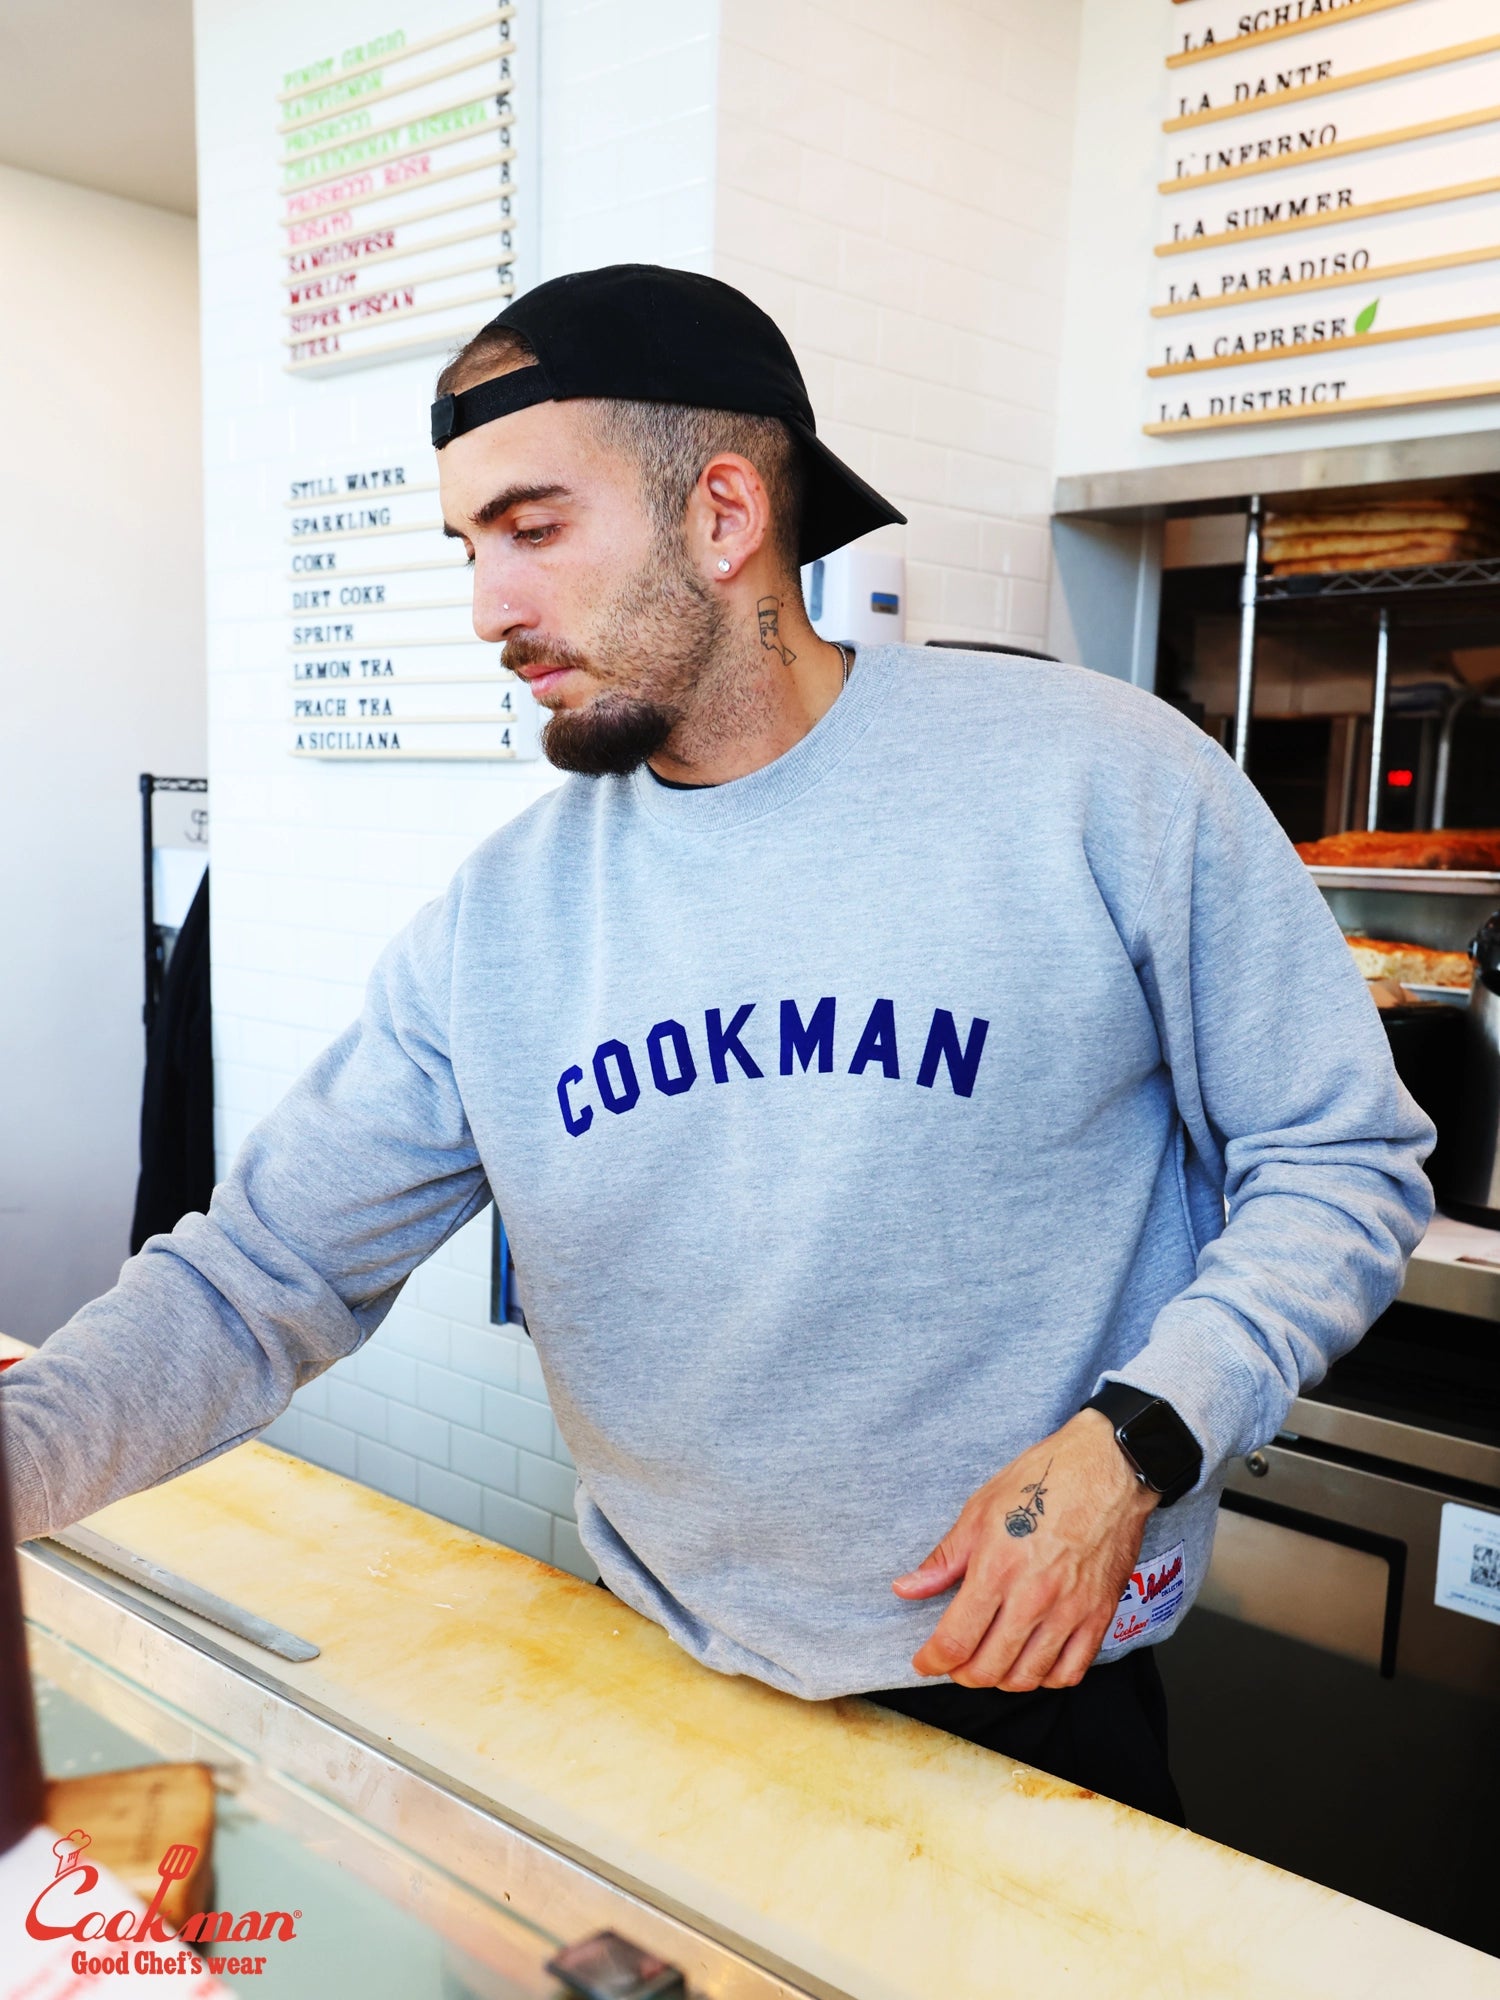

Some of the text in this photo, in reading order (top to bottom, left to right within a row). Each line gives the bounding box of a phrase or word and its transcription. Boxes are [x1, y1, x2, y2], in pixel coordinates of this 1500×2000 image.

[1182, 0, 1362, 53] LA SCHIA
[1179, 59, 1333, 117] LA DANTE
[1173, 189, 1353, 242] LA SUMMER
[1169, 249, 1370, 305] LA PARADISO
[1165, 318, 1347, 365] LA CAPRESE
[1160, 382, 1347, 423] LA DISTRICT
[290, 467, 406, 500] STILL WATER
[292, 508, 391, 536] SPARKLING
[292, 553, 337, 573] COKE
[340, 585, 385, 605] COKE
[294, 624, 353, 644] SPRITE
[295, 659, 394, 680] LEMON TEA
[294, 692, 512, 717] PEACH TEA 4
[501, 728, 511, 748] 4
[557, 997, 989, 1137] COOKMAN
